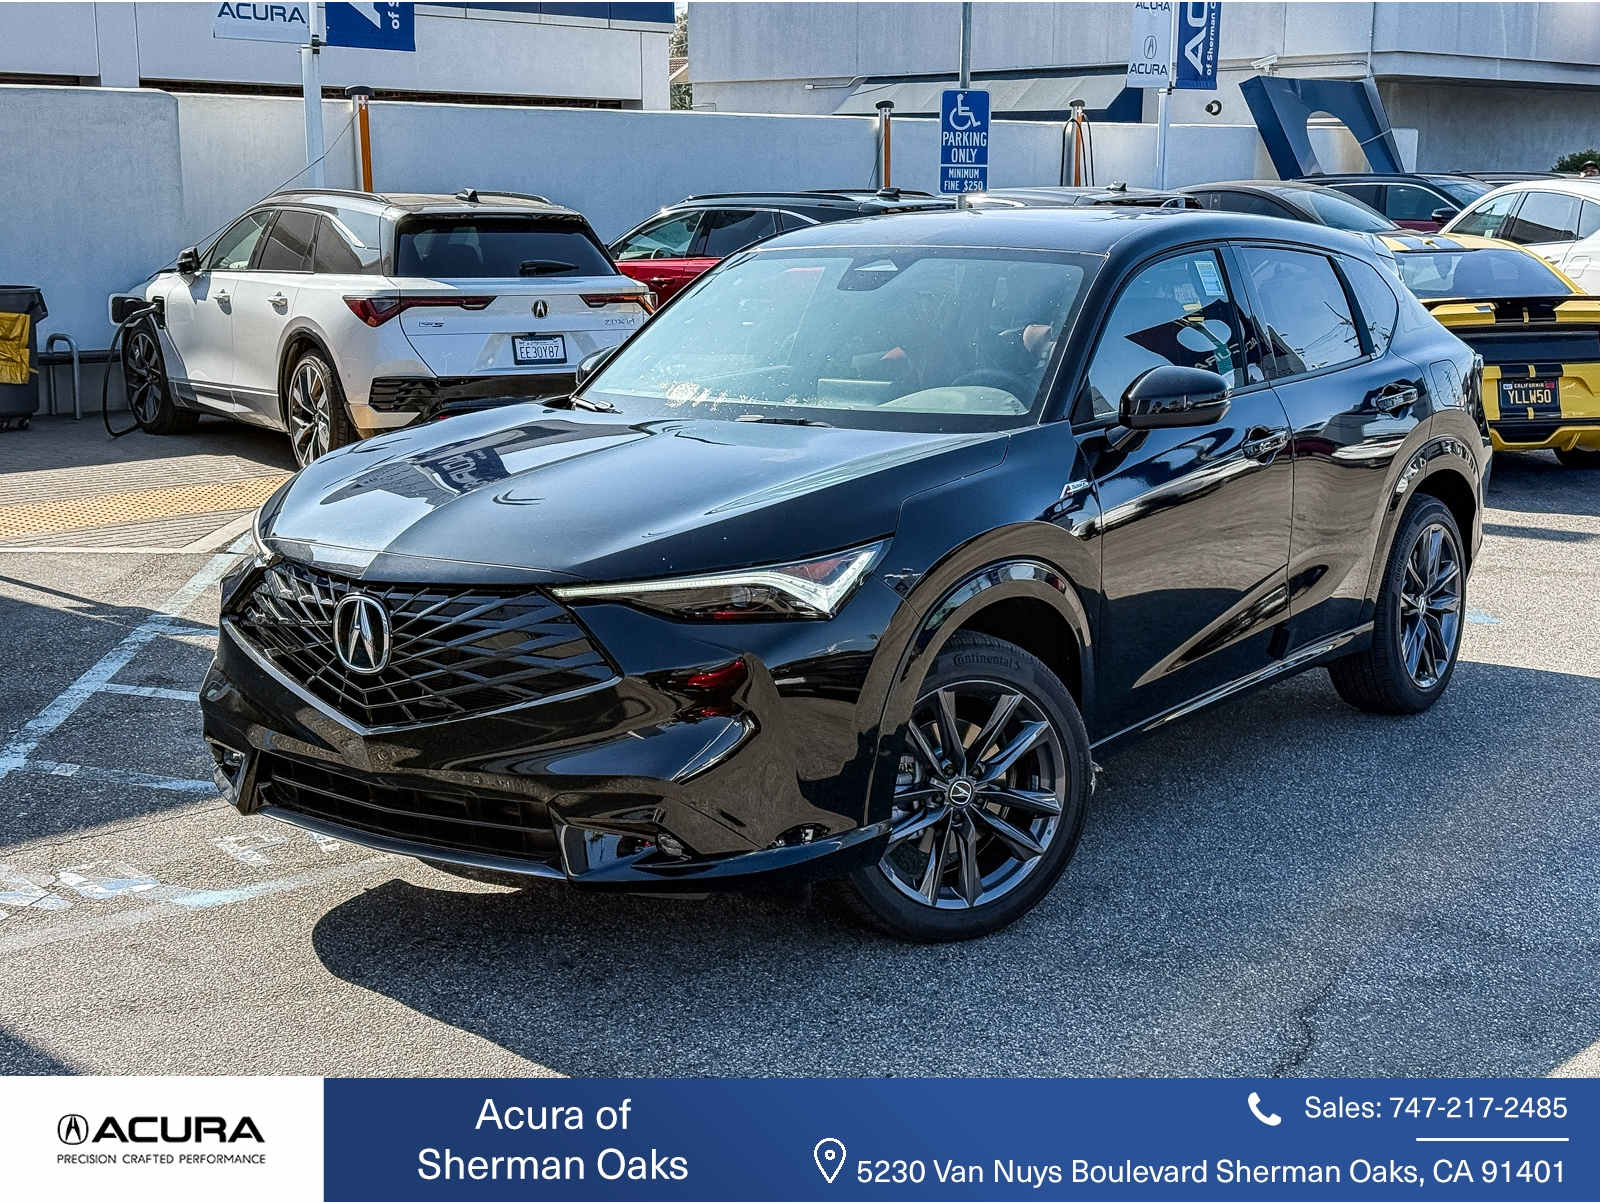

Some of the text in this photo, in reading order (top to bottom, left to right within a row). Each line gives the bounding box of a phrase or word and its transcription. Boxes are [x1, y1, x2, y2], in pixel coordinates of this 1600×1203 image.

[217, 2, 306, 24] ACURA
[1206, 12, 1217, 61] Sherman
[1129, 63, 1168, 75] ACURA
[1206, 64, 1214, 76] of
[942, 131, 987, 147] PARKING
[951, 148, 977, 163] ONLY
[948, 168, 980, 179] MINIMUM
[944, 180, 983, 192] FINE $250
[1507, 389, 1552, 404] YLLW50
[952, 655, 1014, 669] Continental
